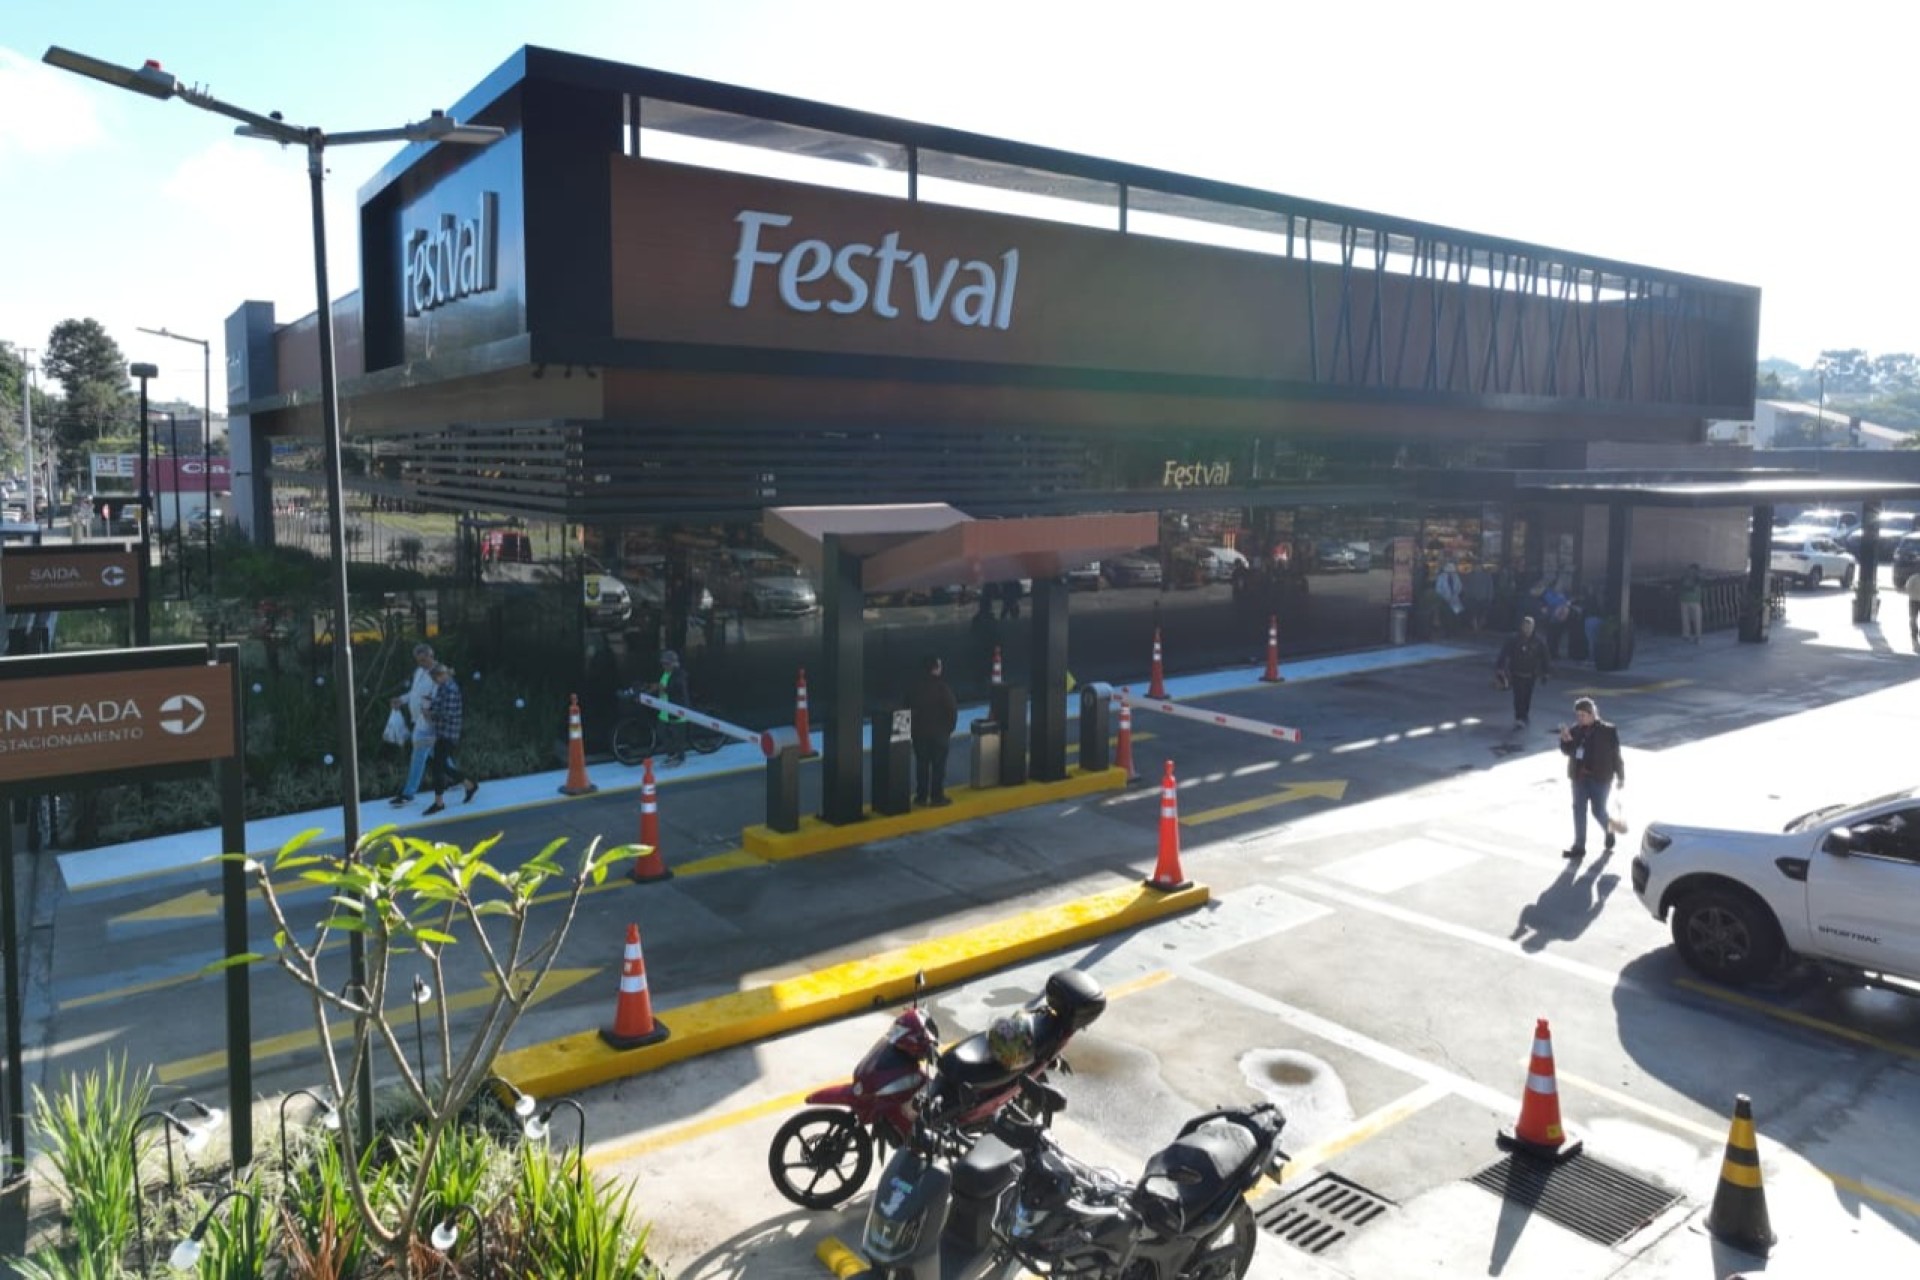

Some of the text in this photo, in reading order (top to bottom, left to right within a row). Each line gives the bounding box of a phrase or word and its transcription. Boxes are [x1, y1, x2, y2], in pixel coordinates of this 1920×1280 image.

[402, 191, 499, 317] Festval
[729, 210, 1019, 330] Festval
[1163, 460, 1230, 488] Festval
[0, 699, 142, 731] NTRADA
